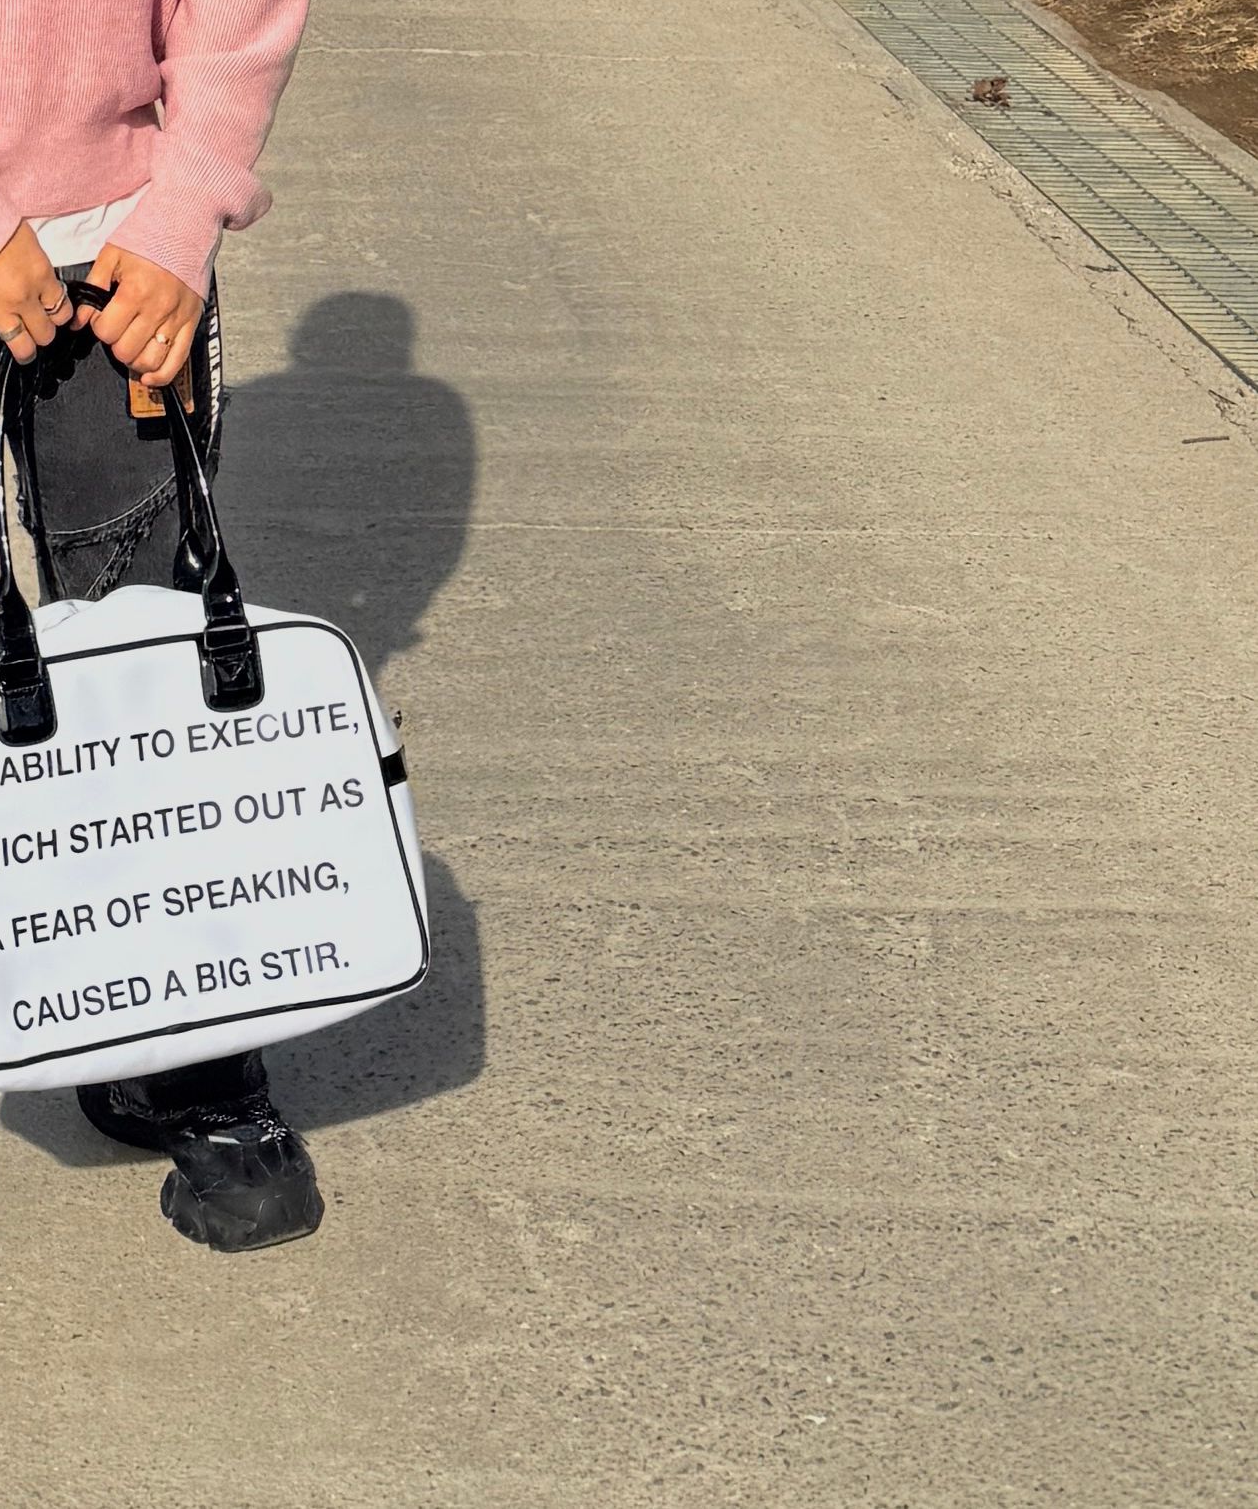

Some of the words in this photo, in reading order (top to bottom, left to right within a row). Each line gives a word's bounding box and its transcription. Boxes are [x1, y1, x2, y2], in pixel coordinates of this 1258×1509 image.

[0, 737, 121, 786] ABILITY
[130, 729, 175, 762] TO
[187, 702, 359, 753] EXECUTE,
[70, 801, 222, 854] STARTED
[234, 787, 306, 824] OUT
[320, 778, 364, 812] AS
[11, 904, 97, 948] FEAR
[106, 892, 151, 927] OF
[162, 861, 349, 916] SPEAKING,
[13, 976, 151, 1031] CAUSED
[164, 969, 188, 1001] A
[195, 957, 251, 993] BIG
[260, 942, 350, 980] STIR.
